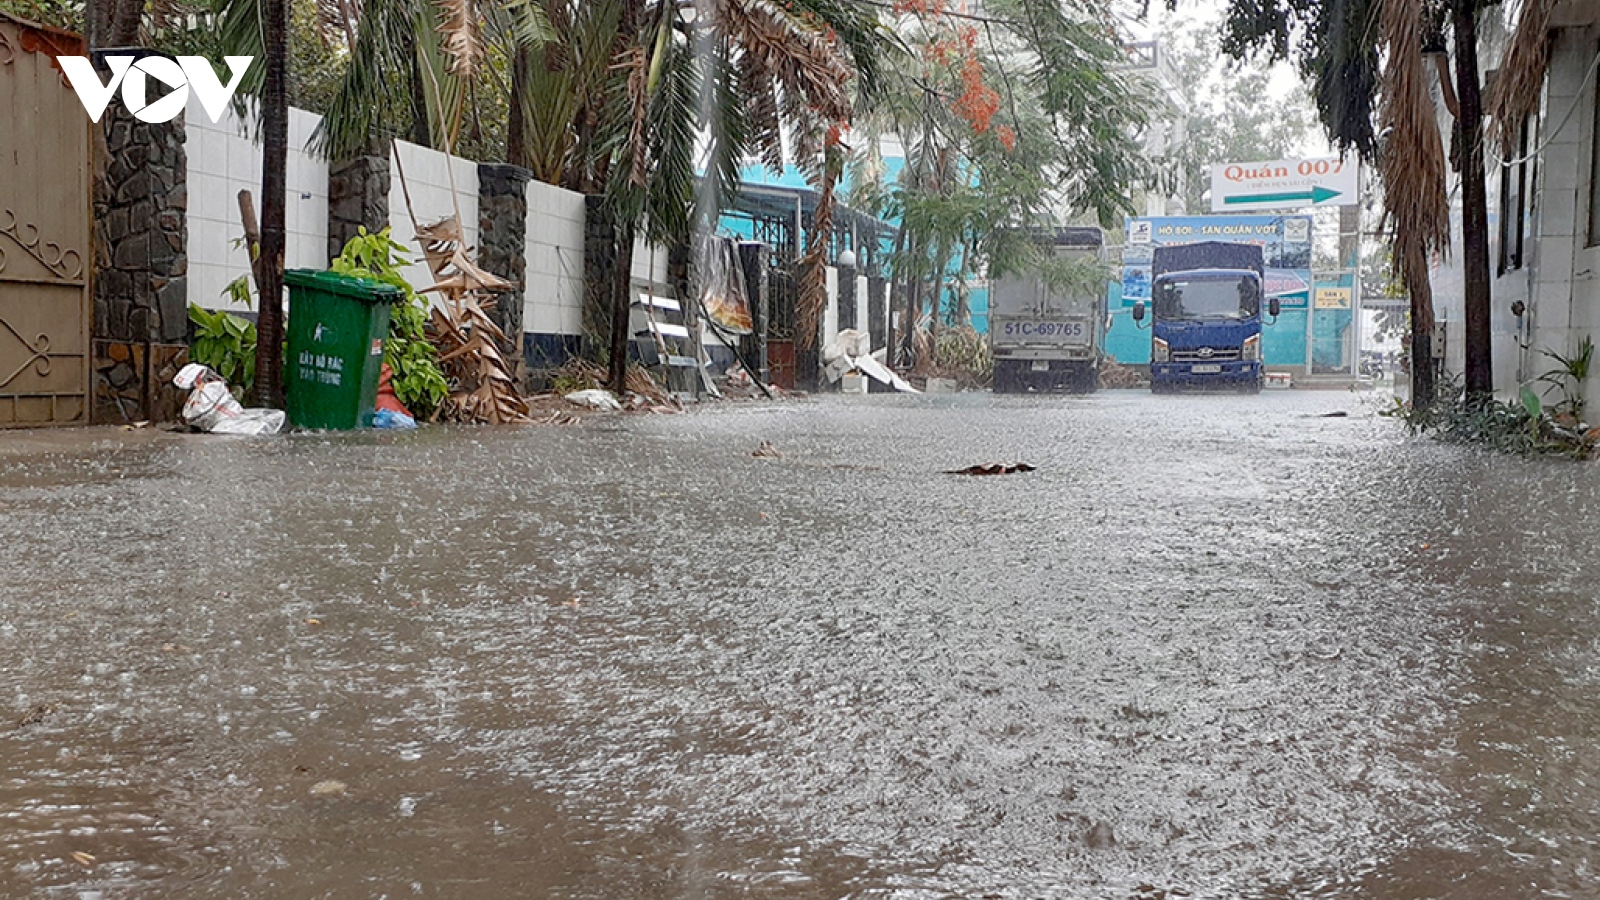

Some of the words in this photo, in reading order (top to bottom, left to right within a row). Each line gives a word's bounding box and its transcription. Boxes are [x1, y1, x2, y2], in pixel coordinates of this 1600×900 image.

[1224, 163, 1288, 182] Quán
[1297, 160, 1343, 176] 007
[1005, 322, 1082, 336] 51C-69765
